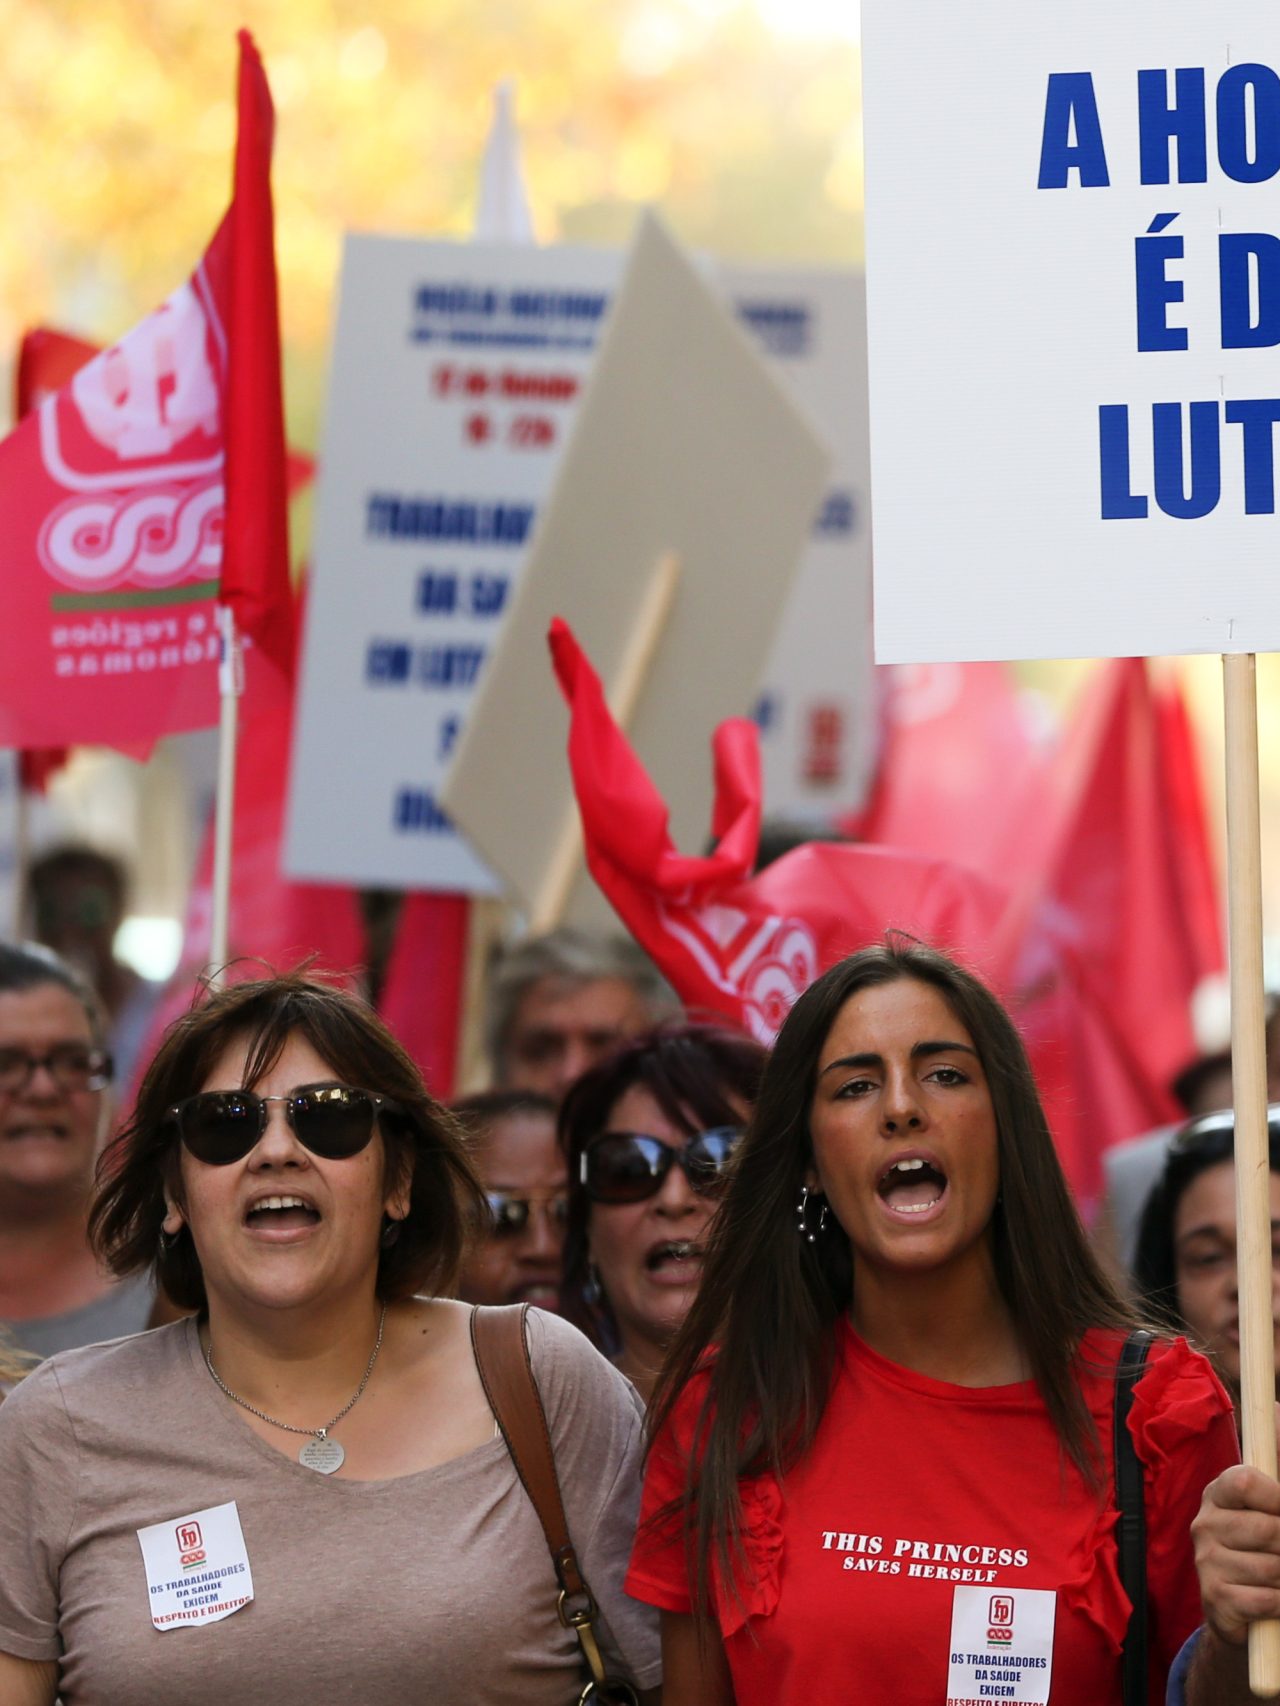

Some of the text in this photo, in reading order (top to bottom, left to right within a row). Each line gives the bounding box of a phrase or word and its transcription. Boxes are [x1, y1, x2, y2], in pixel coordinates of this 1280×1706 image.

[1037, 72, 1111, 189] A
[1135, 212, 1189, 353] É
[822, 1531, 1029, 1567] THIS PRINCESS
[150, 1585, 164, 1594] OS
[165, 1563, 246, 1591] TRABALHADORES
[843, 1557, 998, 1583] SAVES HERSELF
[176, 1581, 223, 1598] DA SAÚDE
[183, 1593, 219, 1609] EXIGEM
[153, 1610, 199, 1624] RESPEITO
[201, 1608, 207, 1616] E
[951, 1653, 1047, 1669] OS TRABALHADORES
[975, 1668, 1021, 1682] DA SAÚDE
[979, 1684, 1015, 1697] EXIGEM
